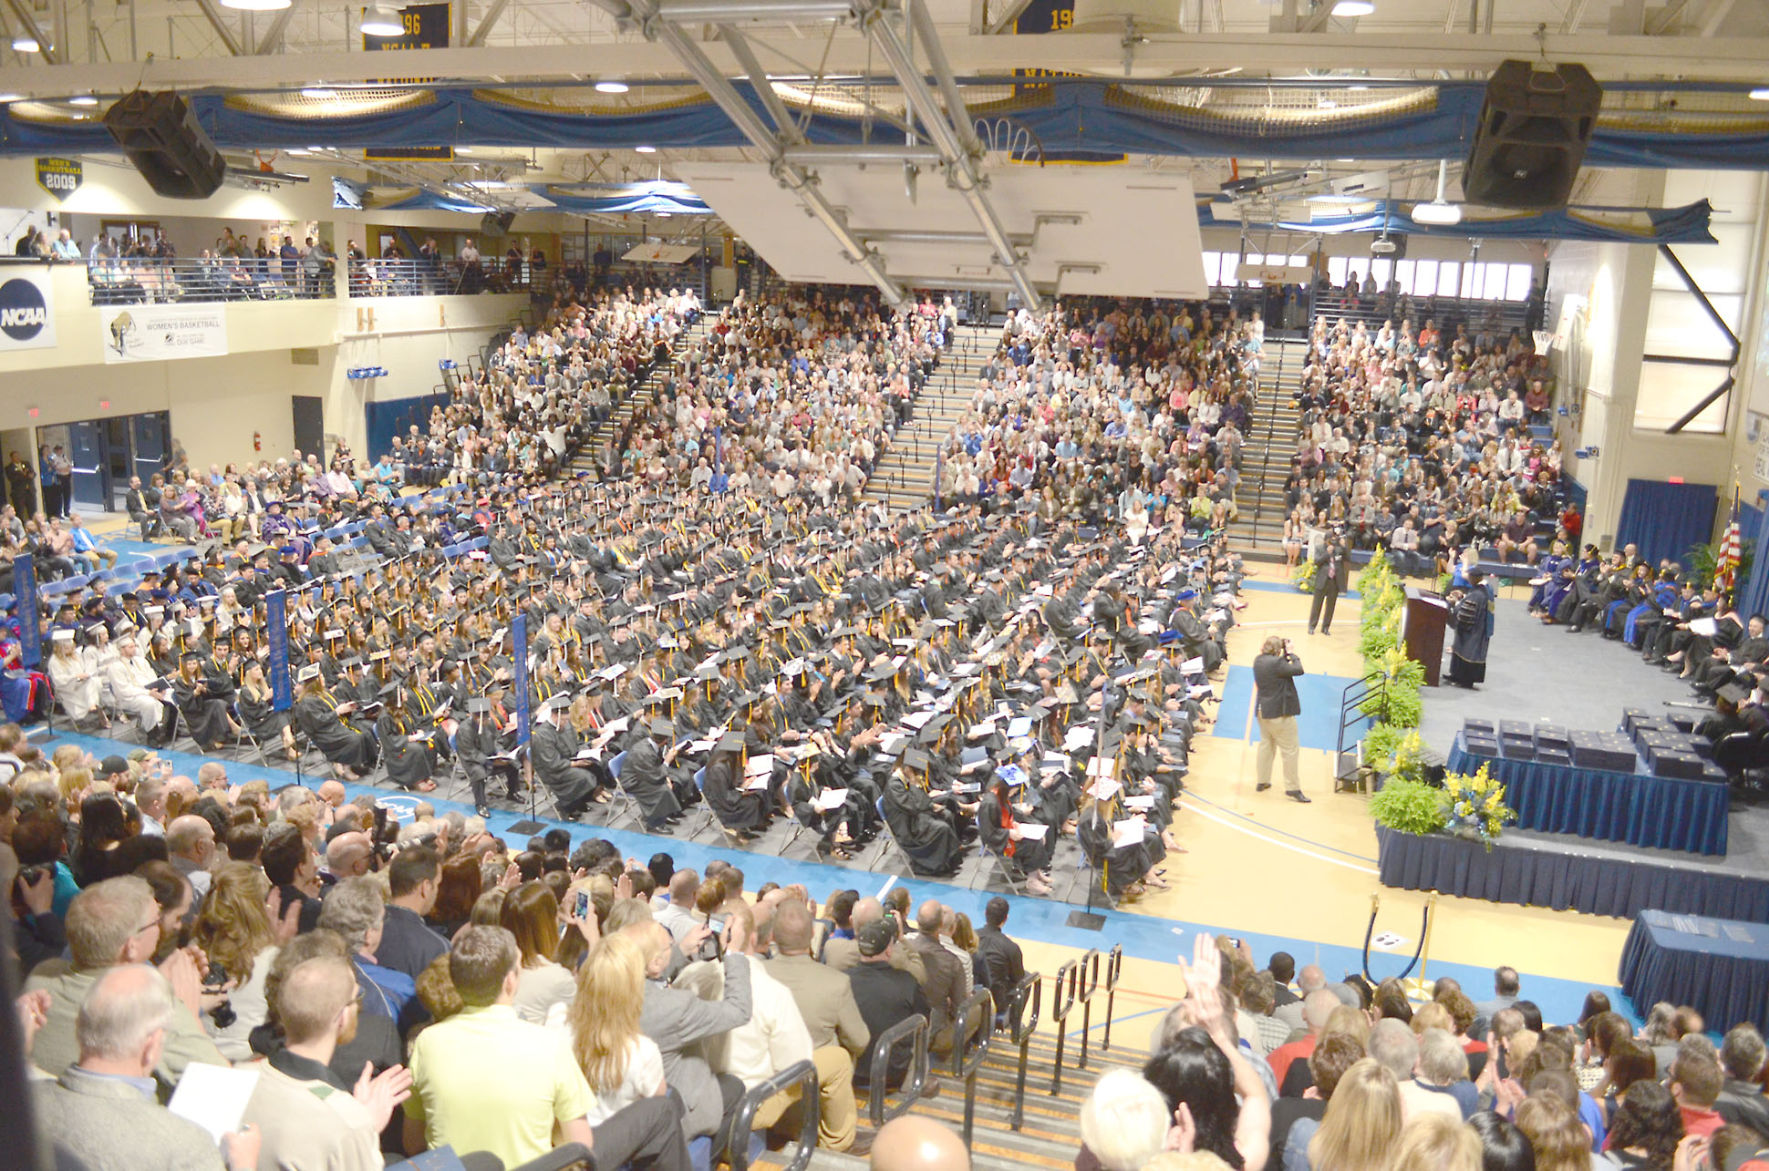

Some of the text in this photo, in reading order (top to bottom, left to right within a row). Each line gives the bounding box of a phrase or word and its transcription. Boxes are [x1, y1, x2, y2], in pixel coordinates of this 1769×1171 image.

[46, 173, 76, 190] 2009
[1, 307, 46, 327] NCAA
[146, 320, 221, 331] WOMEN'S BASKETBALL
